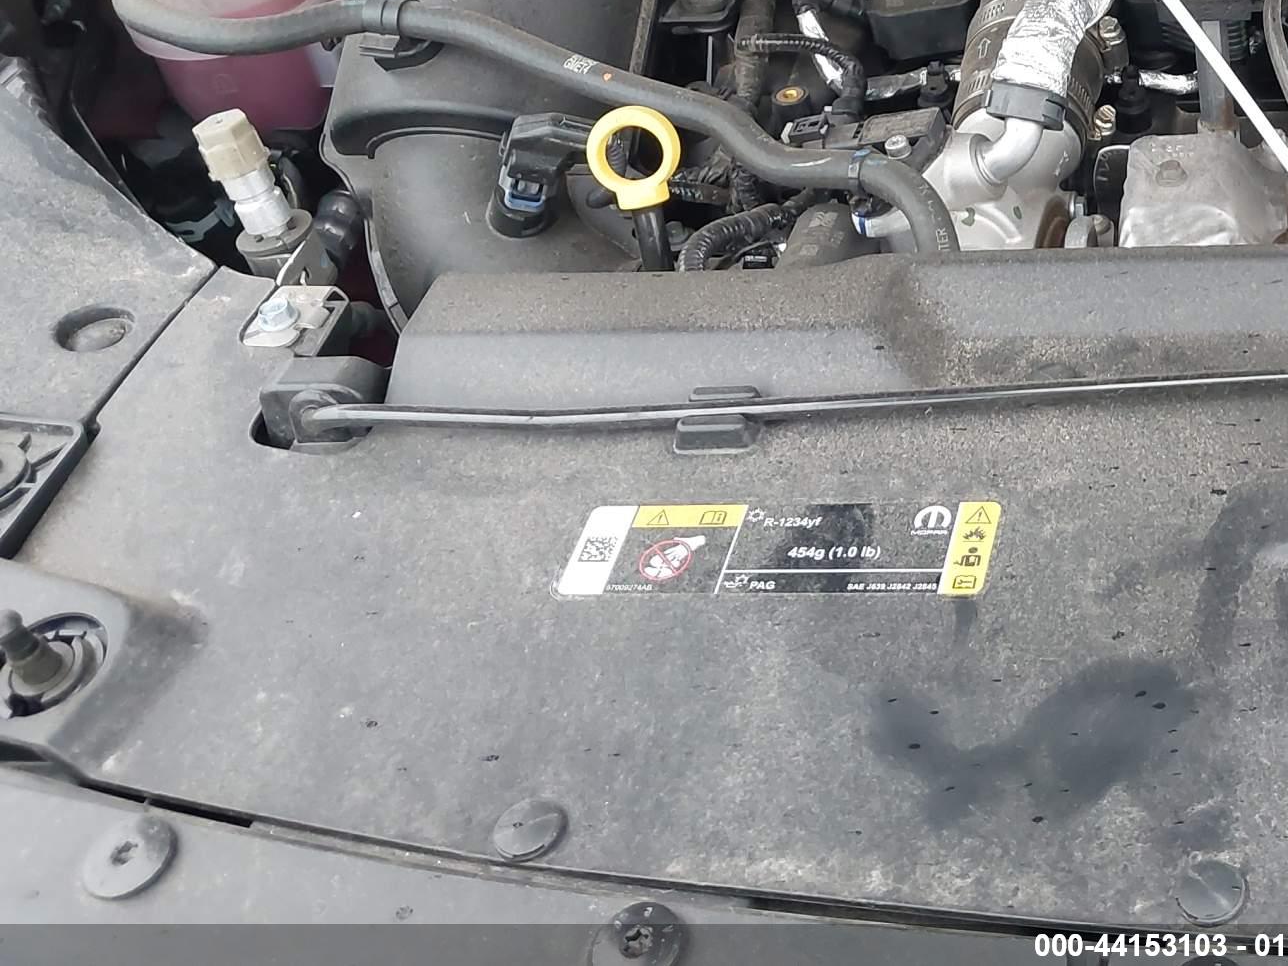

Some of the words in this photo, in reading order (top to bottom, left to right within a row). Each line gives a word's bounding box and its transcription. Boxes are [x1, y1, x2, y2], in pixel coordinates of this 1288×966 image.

[763, 516, 823, 529] R-1234yf
[787, 546, 826, 560] 454g
[828, 546, 857, 559] (1.0
[860, 545, 881, 559] lb)
[749, 580, 776, 590] PAG
